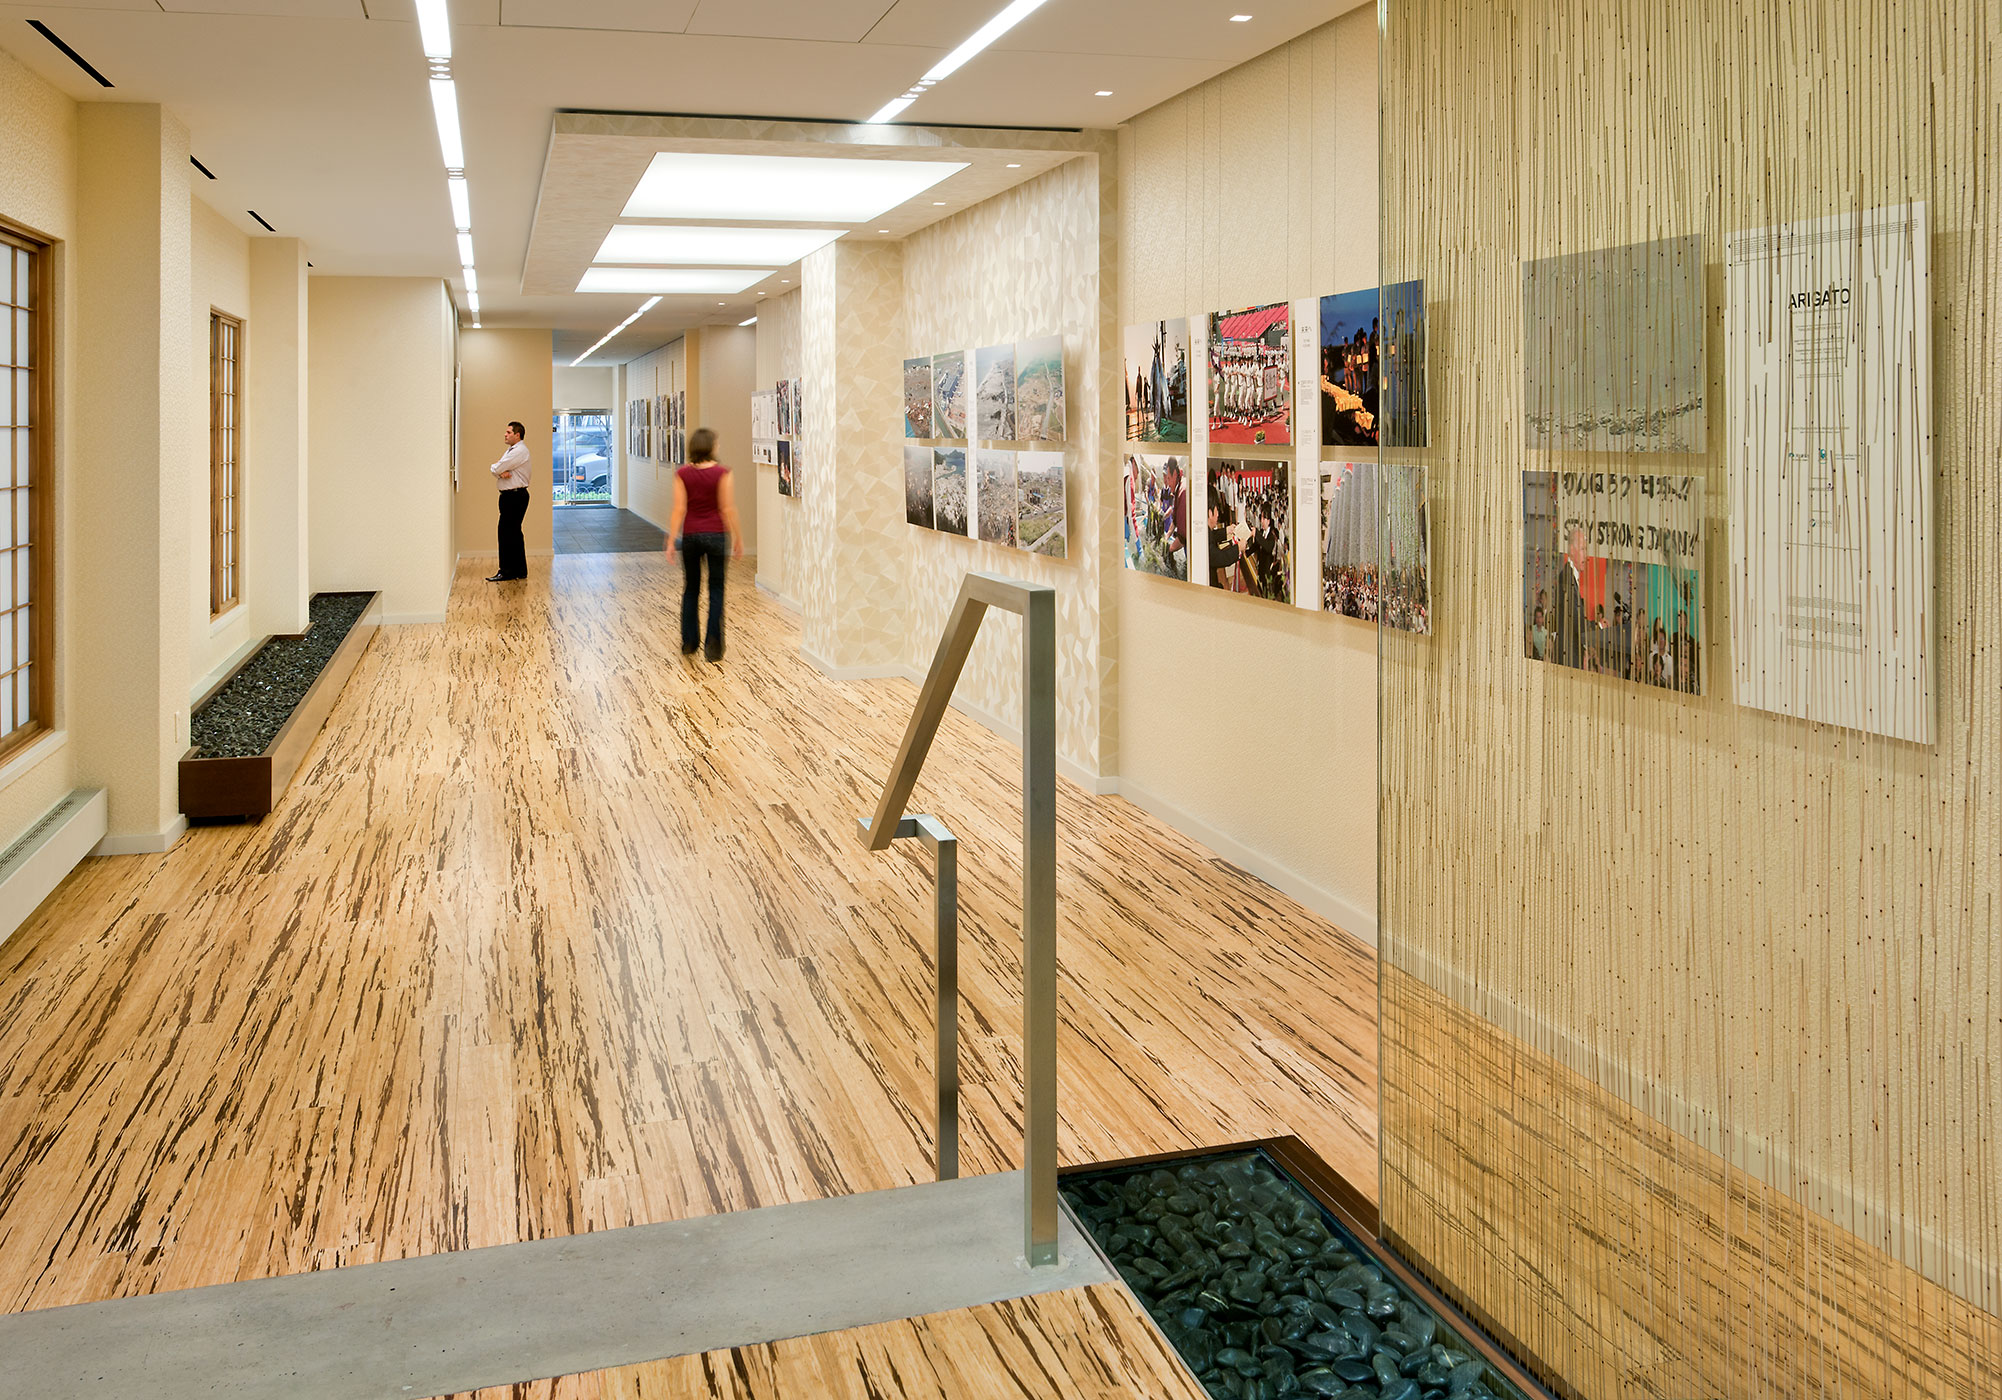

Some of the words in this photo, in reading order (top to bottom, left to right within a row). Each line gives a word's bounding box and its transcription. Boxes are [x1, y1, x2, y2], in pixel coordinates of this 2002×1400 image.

[1788, 288, 1851, 309] ARIGATO
[1564, 519, 1593, 544] STY
[1597, 521, 1645, 550] STRONG
